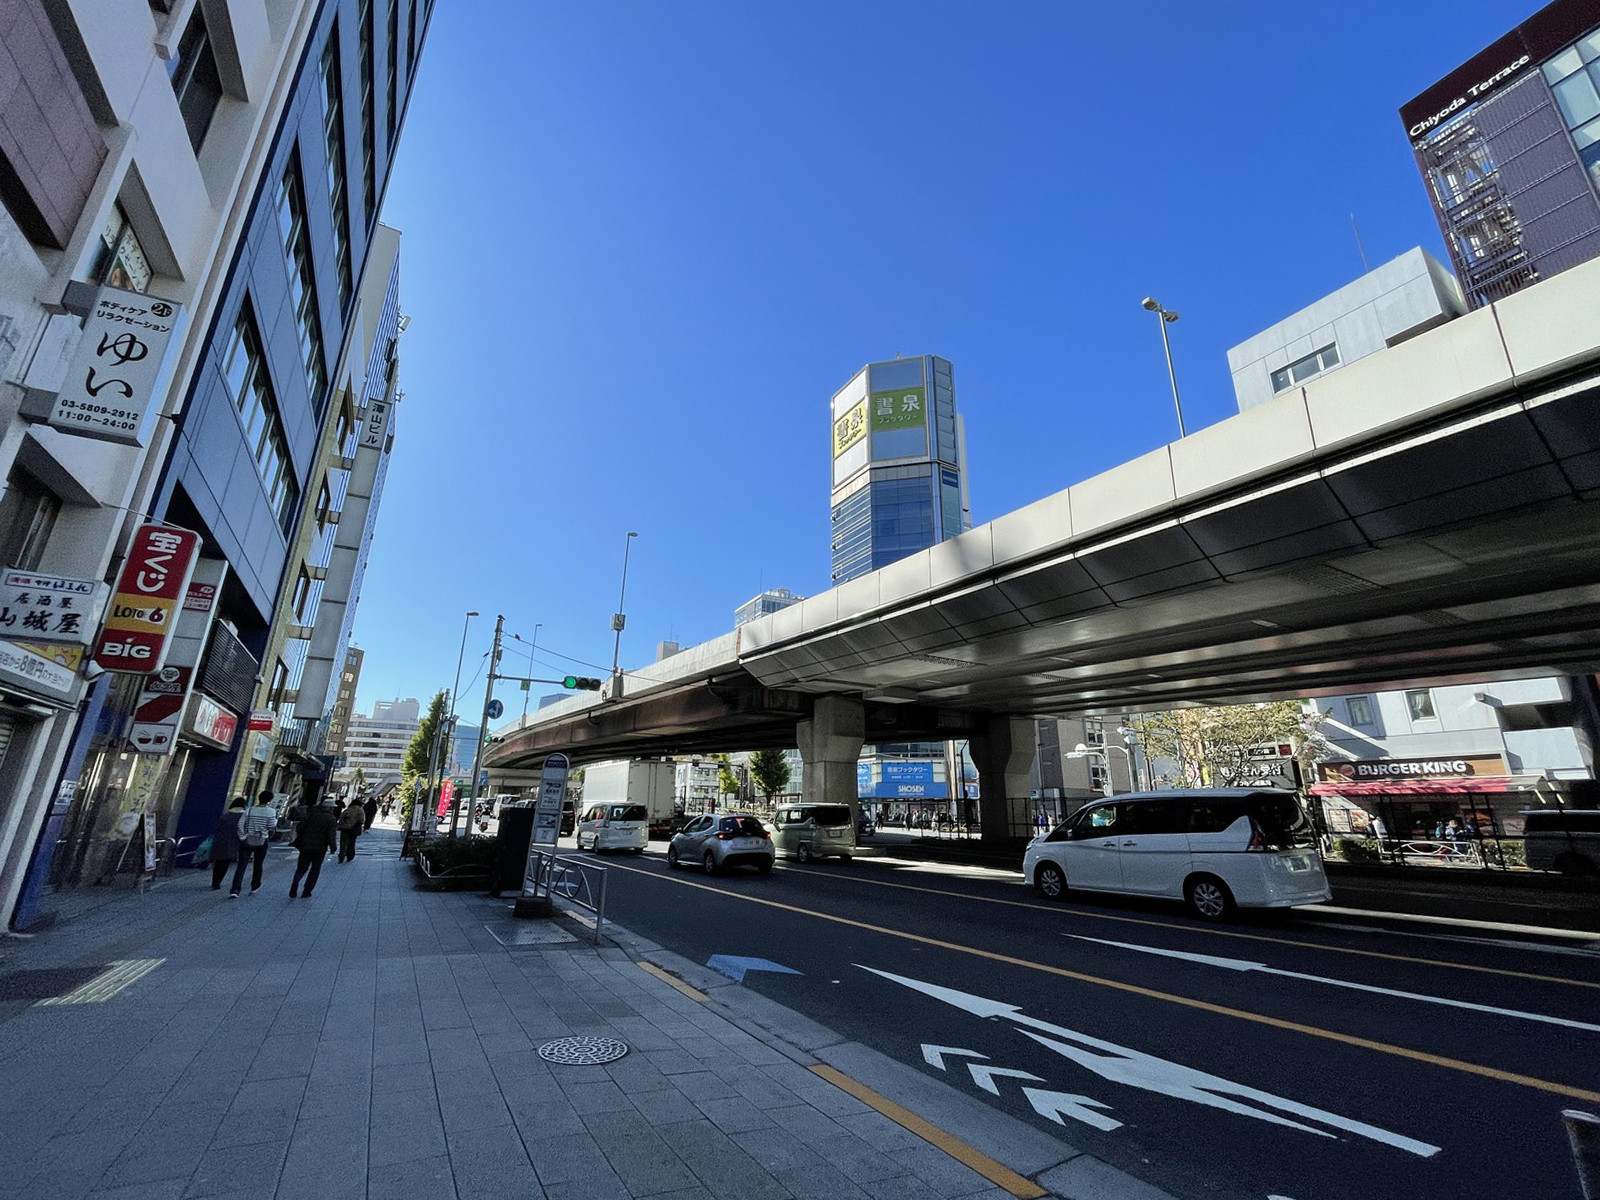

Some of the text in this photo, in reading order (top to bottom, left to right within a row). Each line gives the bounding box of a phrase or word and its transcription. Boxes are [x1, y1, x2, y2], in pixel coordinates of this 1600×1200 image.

[1409, 54, 1530, 137] Chiyoda Terrace
[100, 300, 148, 316] ボディケア
[97, 309, 170, 333] リラクゼーション
[85, 331, 149, 398] ゆい
[61, 399, 139, 421] 03-5809-2912
[876, 394, 920, 416] 書泉
[135, 531, 183, 593] 宝くじ
[14, 592, 73, 609] 居酒屋
[0, 606, 81, 635] 山城屋
[148, 608, 165, 622] 6
[101, 640, 152, 659] BIG
[1358, 760, 1467, 776] BURGER KING
[898, 784, 925, 793] SHOSEN
